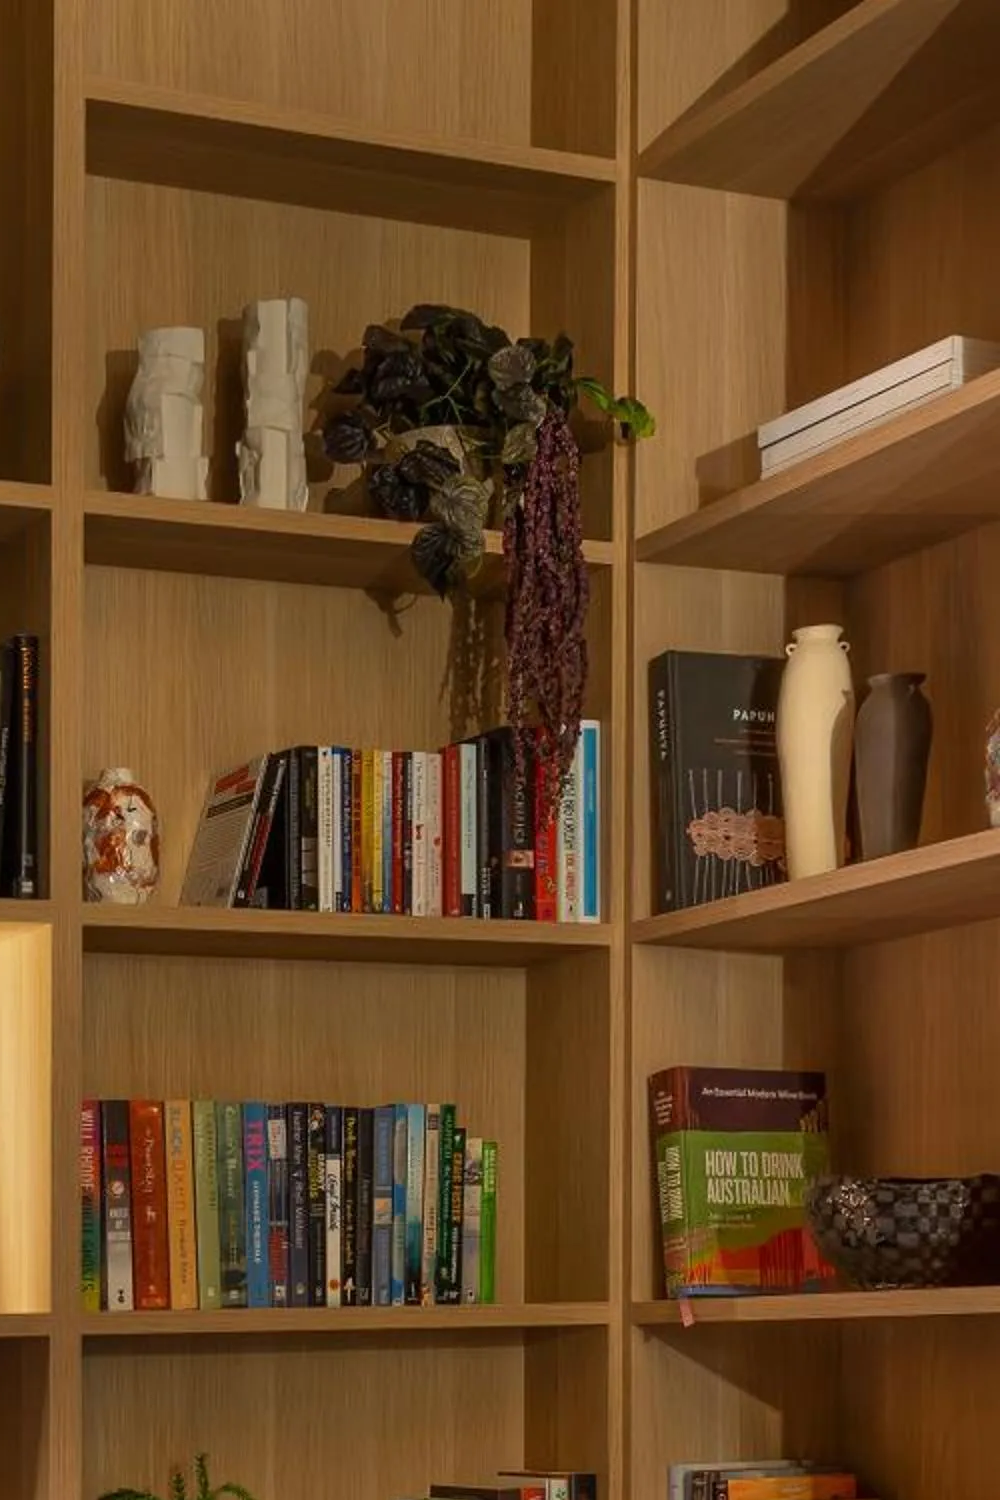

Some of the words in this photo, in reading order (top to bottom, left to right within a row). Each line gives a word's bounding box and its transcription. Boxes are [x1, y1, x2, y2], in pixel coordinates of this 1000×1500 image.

[247, 1120, 265, 1171] TRIX
[704, 1150, 737, 1177] HOW
[740, 1151, 759, 1177] TO
[762, 1151, 805, 1179] DRINK
[706, 1178, 792, 1206] AUSTRALIAN
